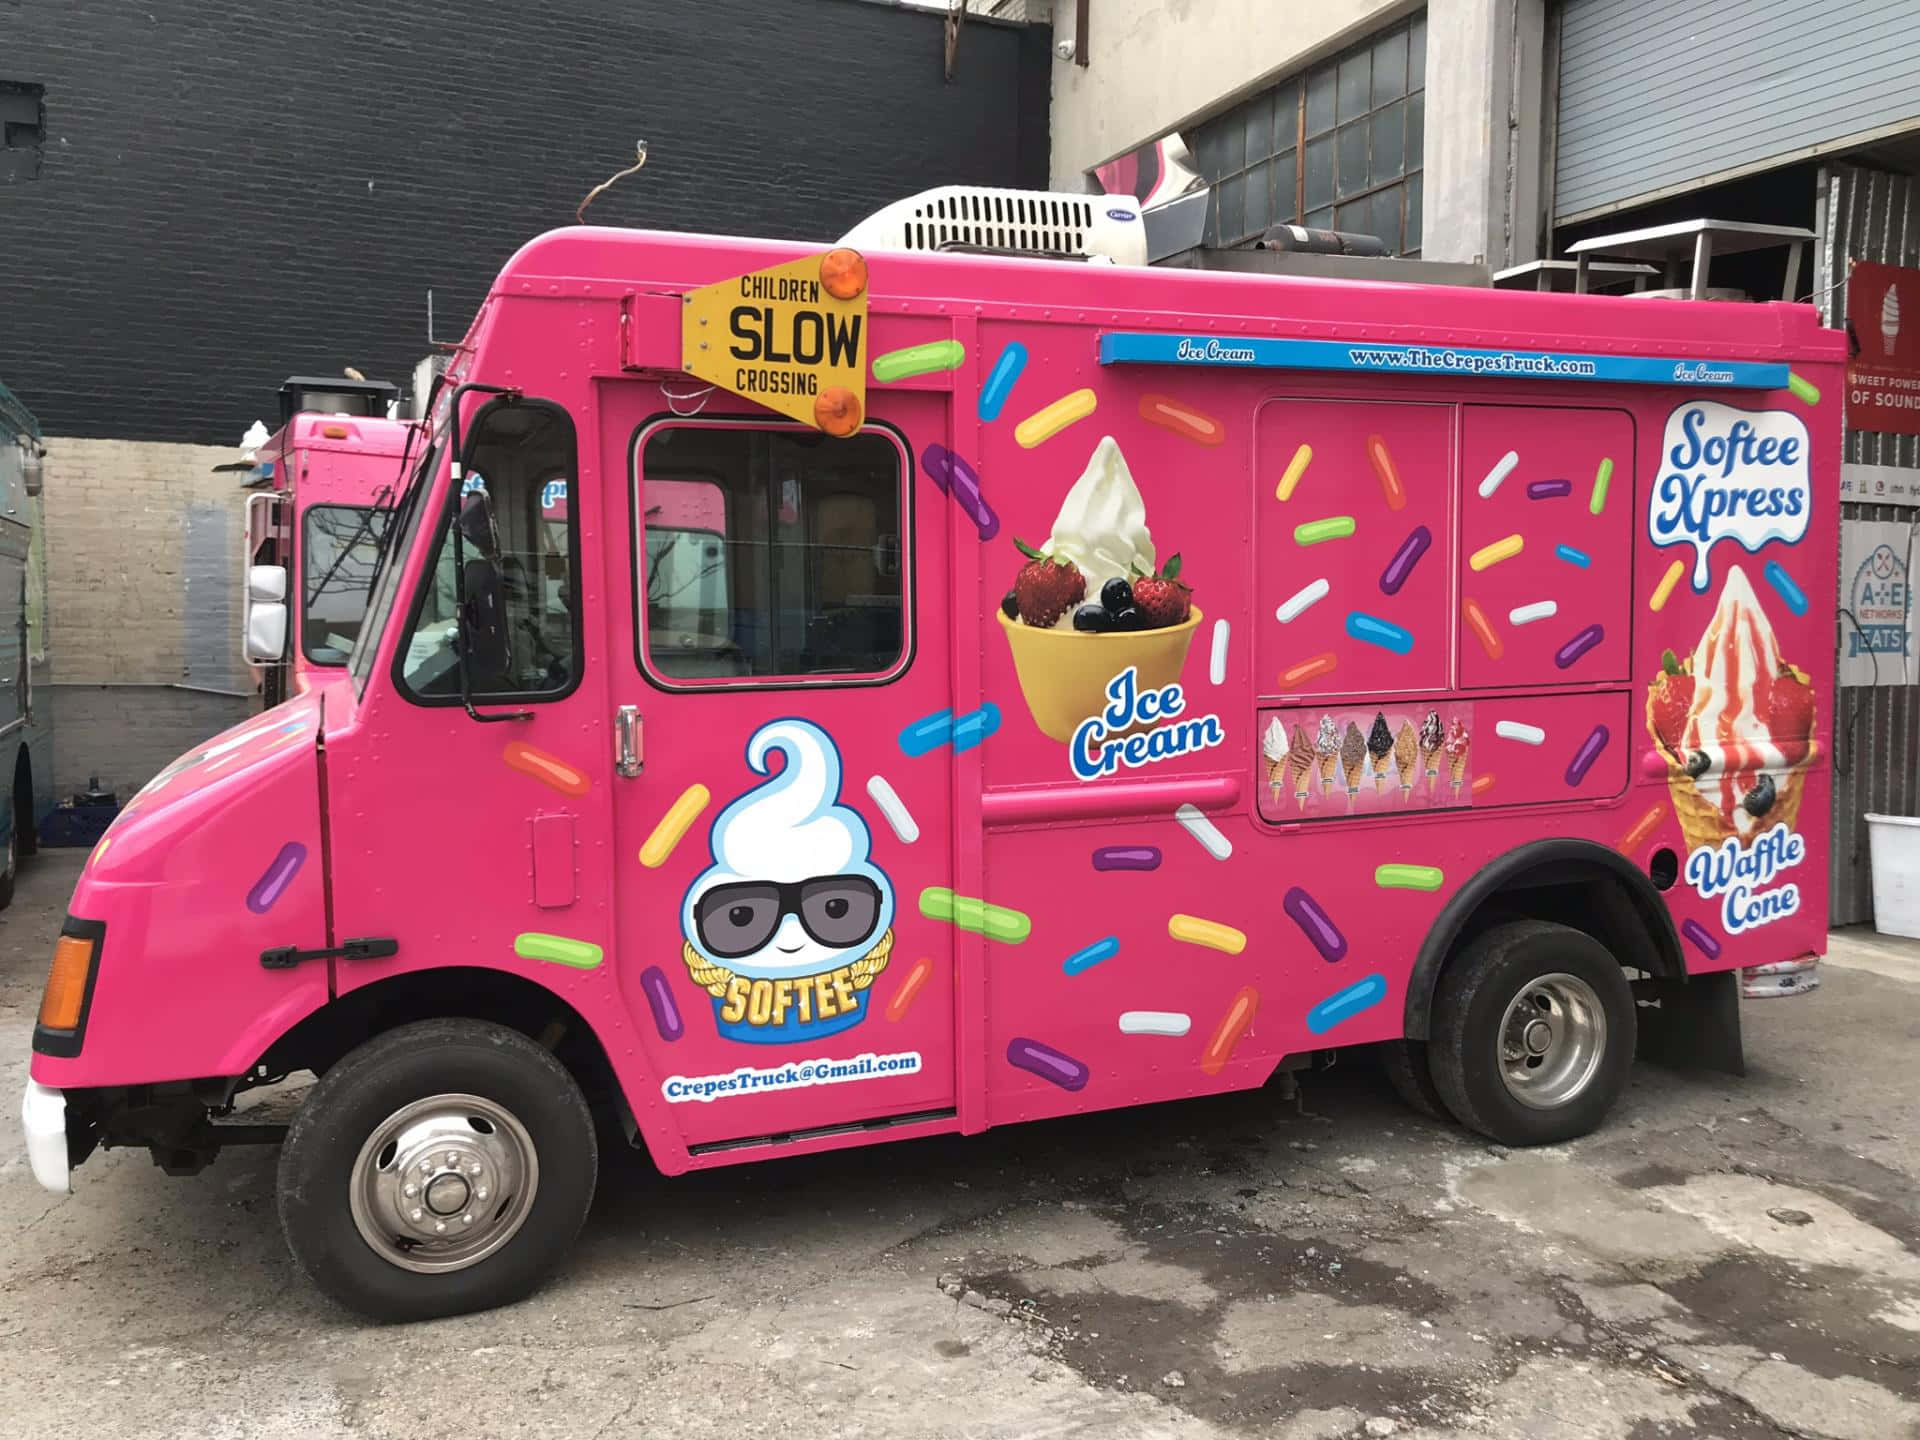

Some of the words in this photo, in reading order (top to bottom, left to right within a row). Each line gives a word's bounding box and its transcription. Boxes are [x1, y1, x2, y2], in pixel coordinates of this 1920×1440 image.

[741, 275, 819, 303] CHILDREN
[729, 305, 862, 368] SLOW
[1178, 339, 1204, 360] Ice
[1206, 340, 1254, 361] Cream
[736, 368, 817, 395] CROSSING
[1350, 350, 1595, 375] www.TheCrepesTruck.com
[1674, 363, 1695, 381] Ice
[1696, 363, 1734, 382] Cream
[1851, 390, 1870, 404] OF
[1670, 408, 1799, 478] Softee
[1656, 473, 1803, 542] Xpress
[1106, 669, 1182, 728] Ice
[1073, 717, 1222, 777] Cream
[1689, 828, 1800, 893] Waffle
[1726, 885, 1795, 929] Cone
[720, 966, 858, 1026] SOFTEE
[667, 1054, 917, 1098] CrepesTruck@Gmail.com
